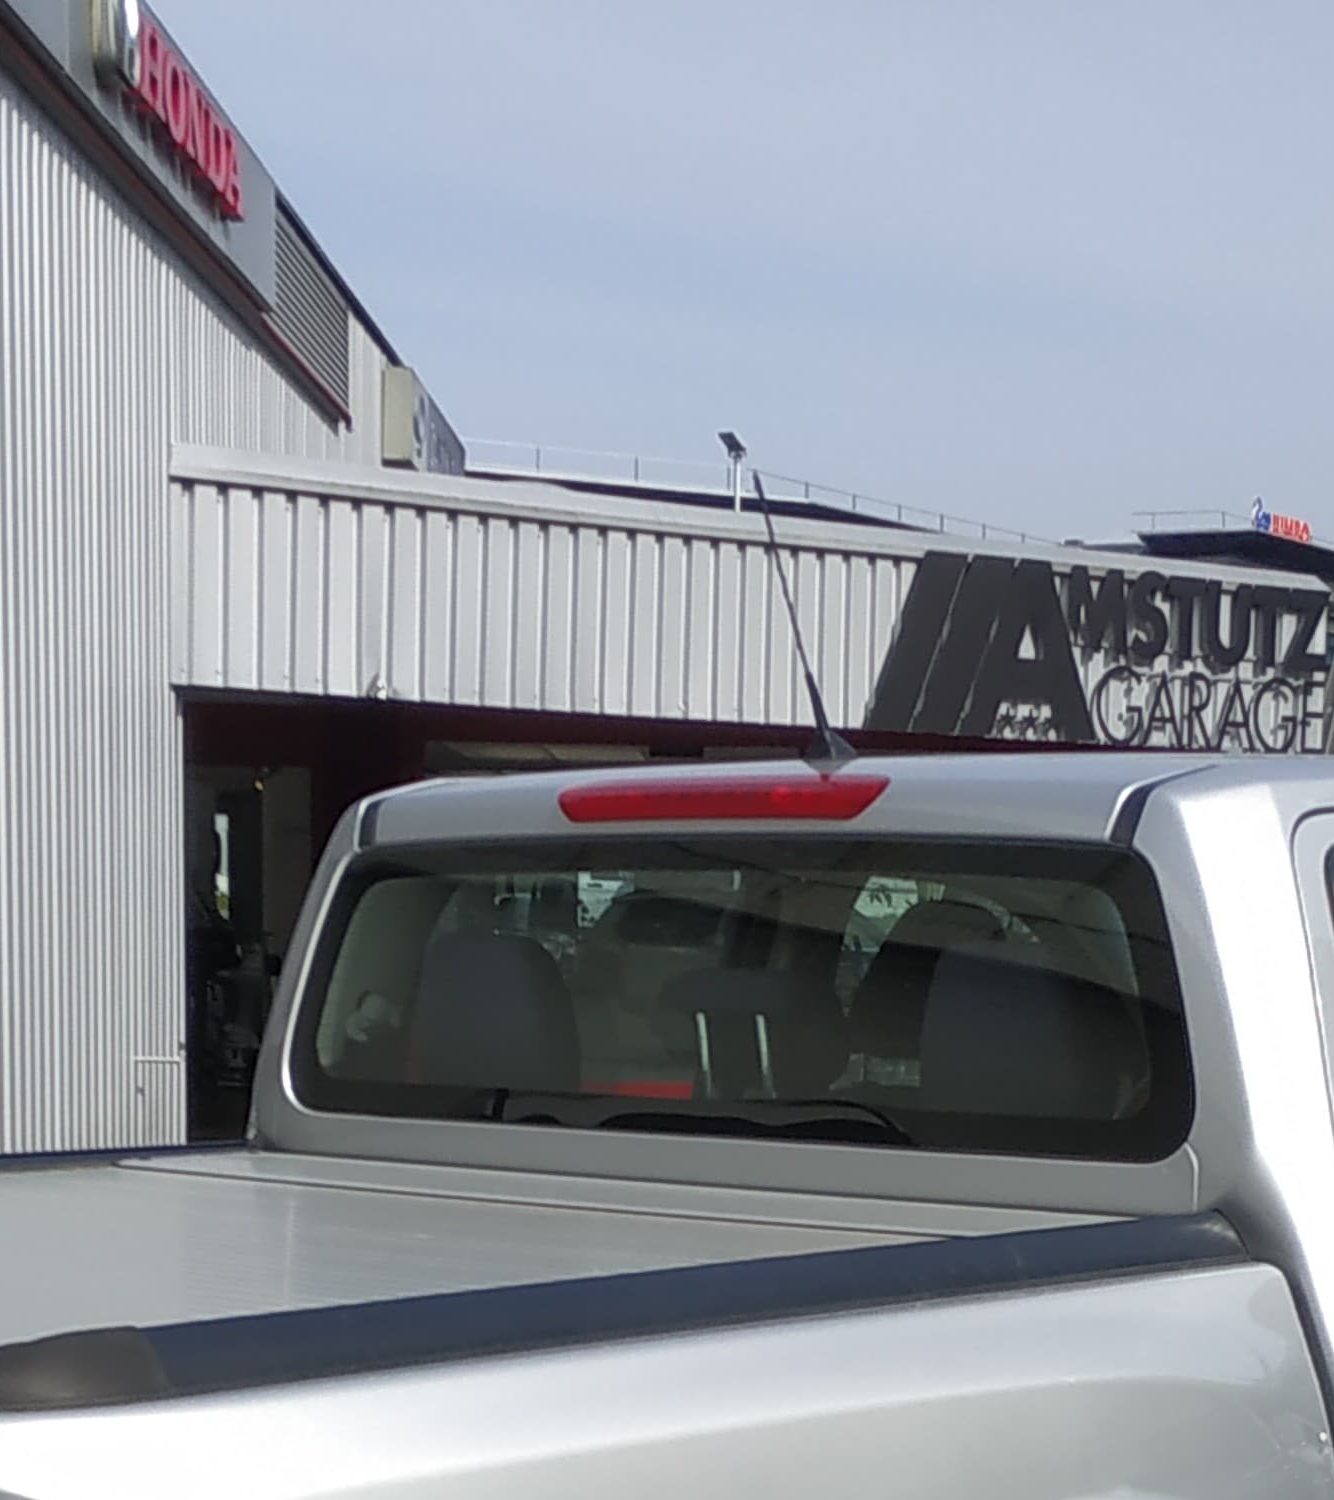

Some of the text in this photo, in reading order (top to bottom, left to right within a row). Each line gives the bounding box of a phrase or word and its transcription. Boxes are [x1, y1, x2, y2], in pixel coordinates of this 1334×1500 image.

[140, 12, 244, 218] HONDA
[955, 557, 1331, 743] AMSTUTZ
[1095, 665, 1324, 755] GARAGE
